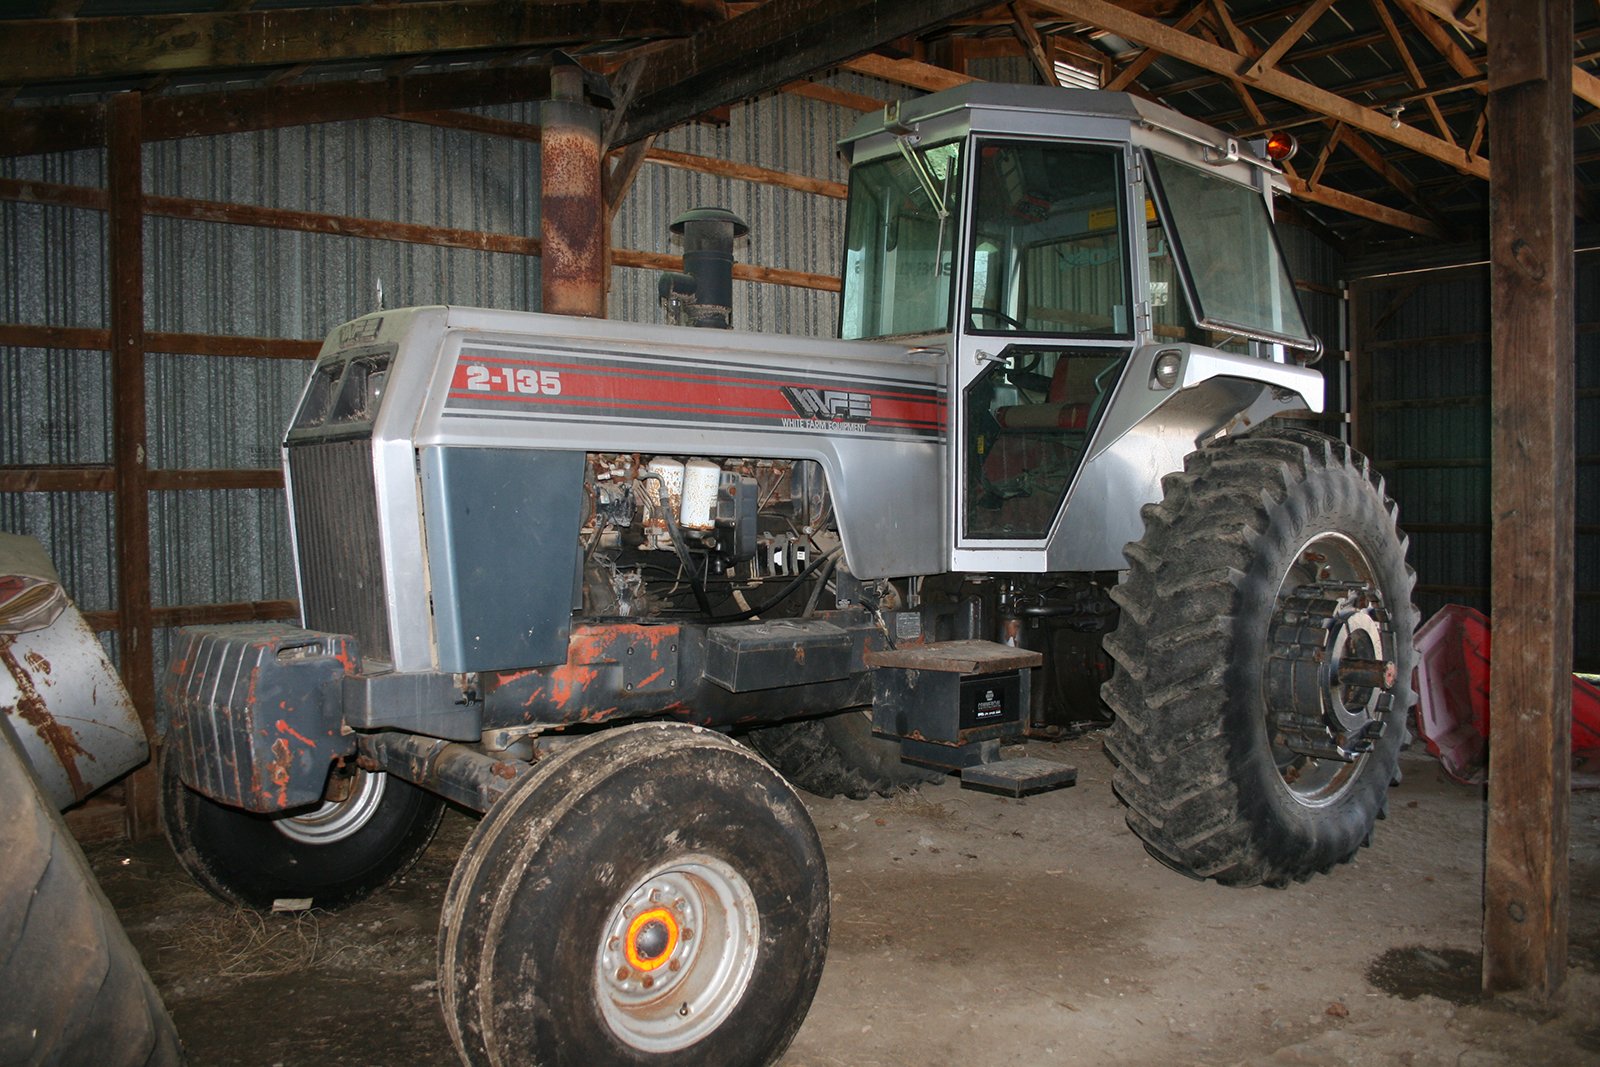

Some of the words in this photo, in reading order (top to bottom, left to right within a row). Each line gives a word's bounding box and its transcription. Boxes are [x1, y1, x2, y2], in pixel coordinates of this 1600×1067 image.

[466, 365, 561, 395] 2-135
[781, 418, 804, 428] WHITE
[806, 420, 827, 430] FARM
[828, 421, 866, 432] EQUIPMENT
